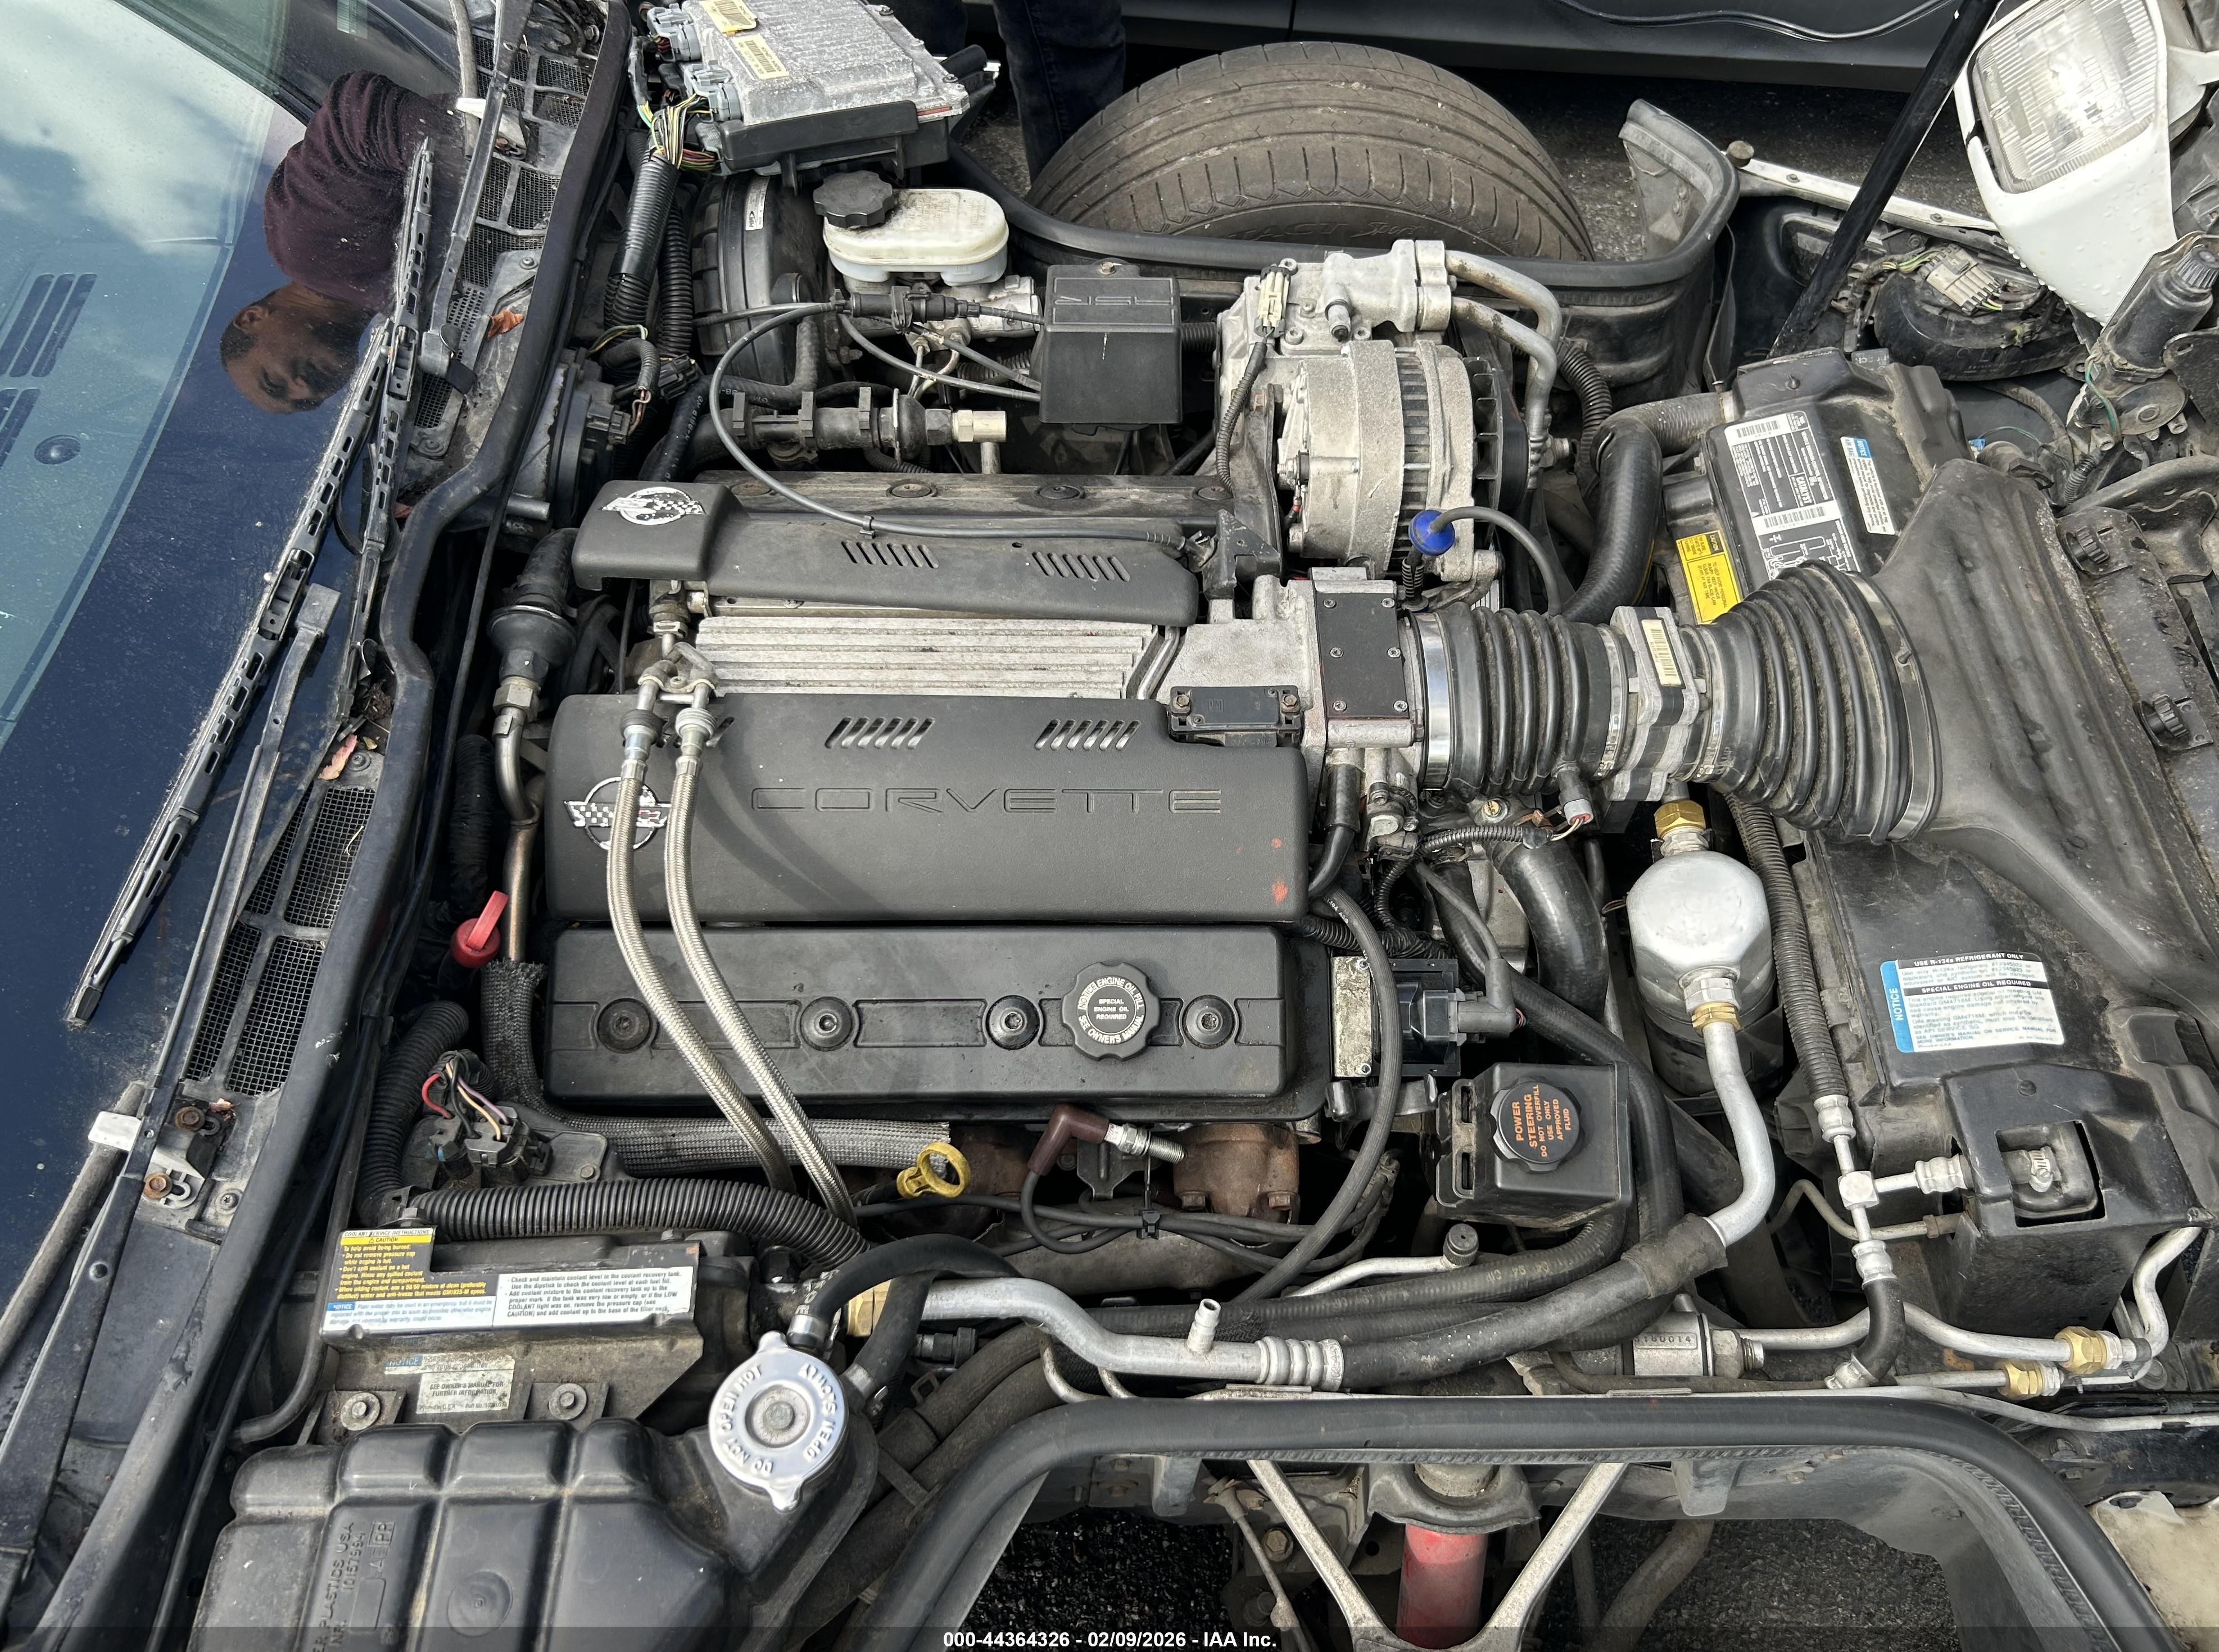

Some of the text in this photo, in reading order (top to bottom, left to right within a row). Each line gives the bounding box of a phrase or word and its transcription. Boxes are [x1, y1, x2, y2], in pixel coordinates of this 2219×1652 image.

[1350, 221, 1424, 238] Sport
[1846, 447, 1855, 456] BAG
[1856, 440, 1868, 456] NOTICE
[1795, 476, 1812, 504] CATALYST
[1709, 534, 1719, 551] CAUTION
[1718, 588, 1728, 608] PERSONAL
[750, 787, 1222, 814] CORVETTE
[1955, 953, 2005, 963] REFRIGERANT
[1079, 977, 1144, 1009] NOTICE ENGINE OIL FILL
[1888, 988, 1904, 1021] NOTICE
[1079, 1014, 1144, 1043] SEE OWNER'S MANUAL
[1533, 1084, 1542, 1121] OVERFILL
[1512, 1101, 1524, 1141] POWER
[1524, 1093, 1538, 1147] STEERING
[1553, 1099, 1564, 1140] APPROVED
[1540, 1145, 1547, 1157] DO
[720, 1364, 774, 1474] DO NOT OPEN HOT
[804, 1418, 836, 1460] OPEN
[374, 1523, 392, 1542] PP
[319, 1559, 345, 1628] PLASTICS
[337, 1522, 354, 1553] USA
[340, 1533, 365, 1592] 10157994
